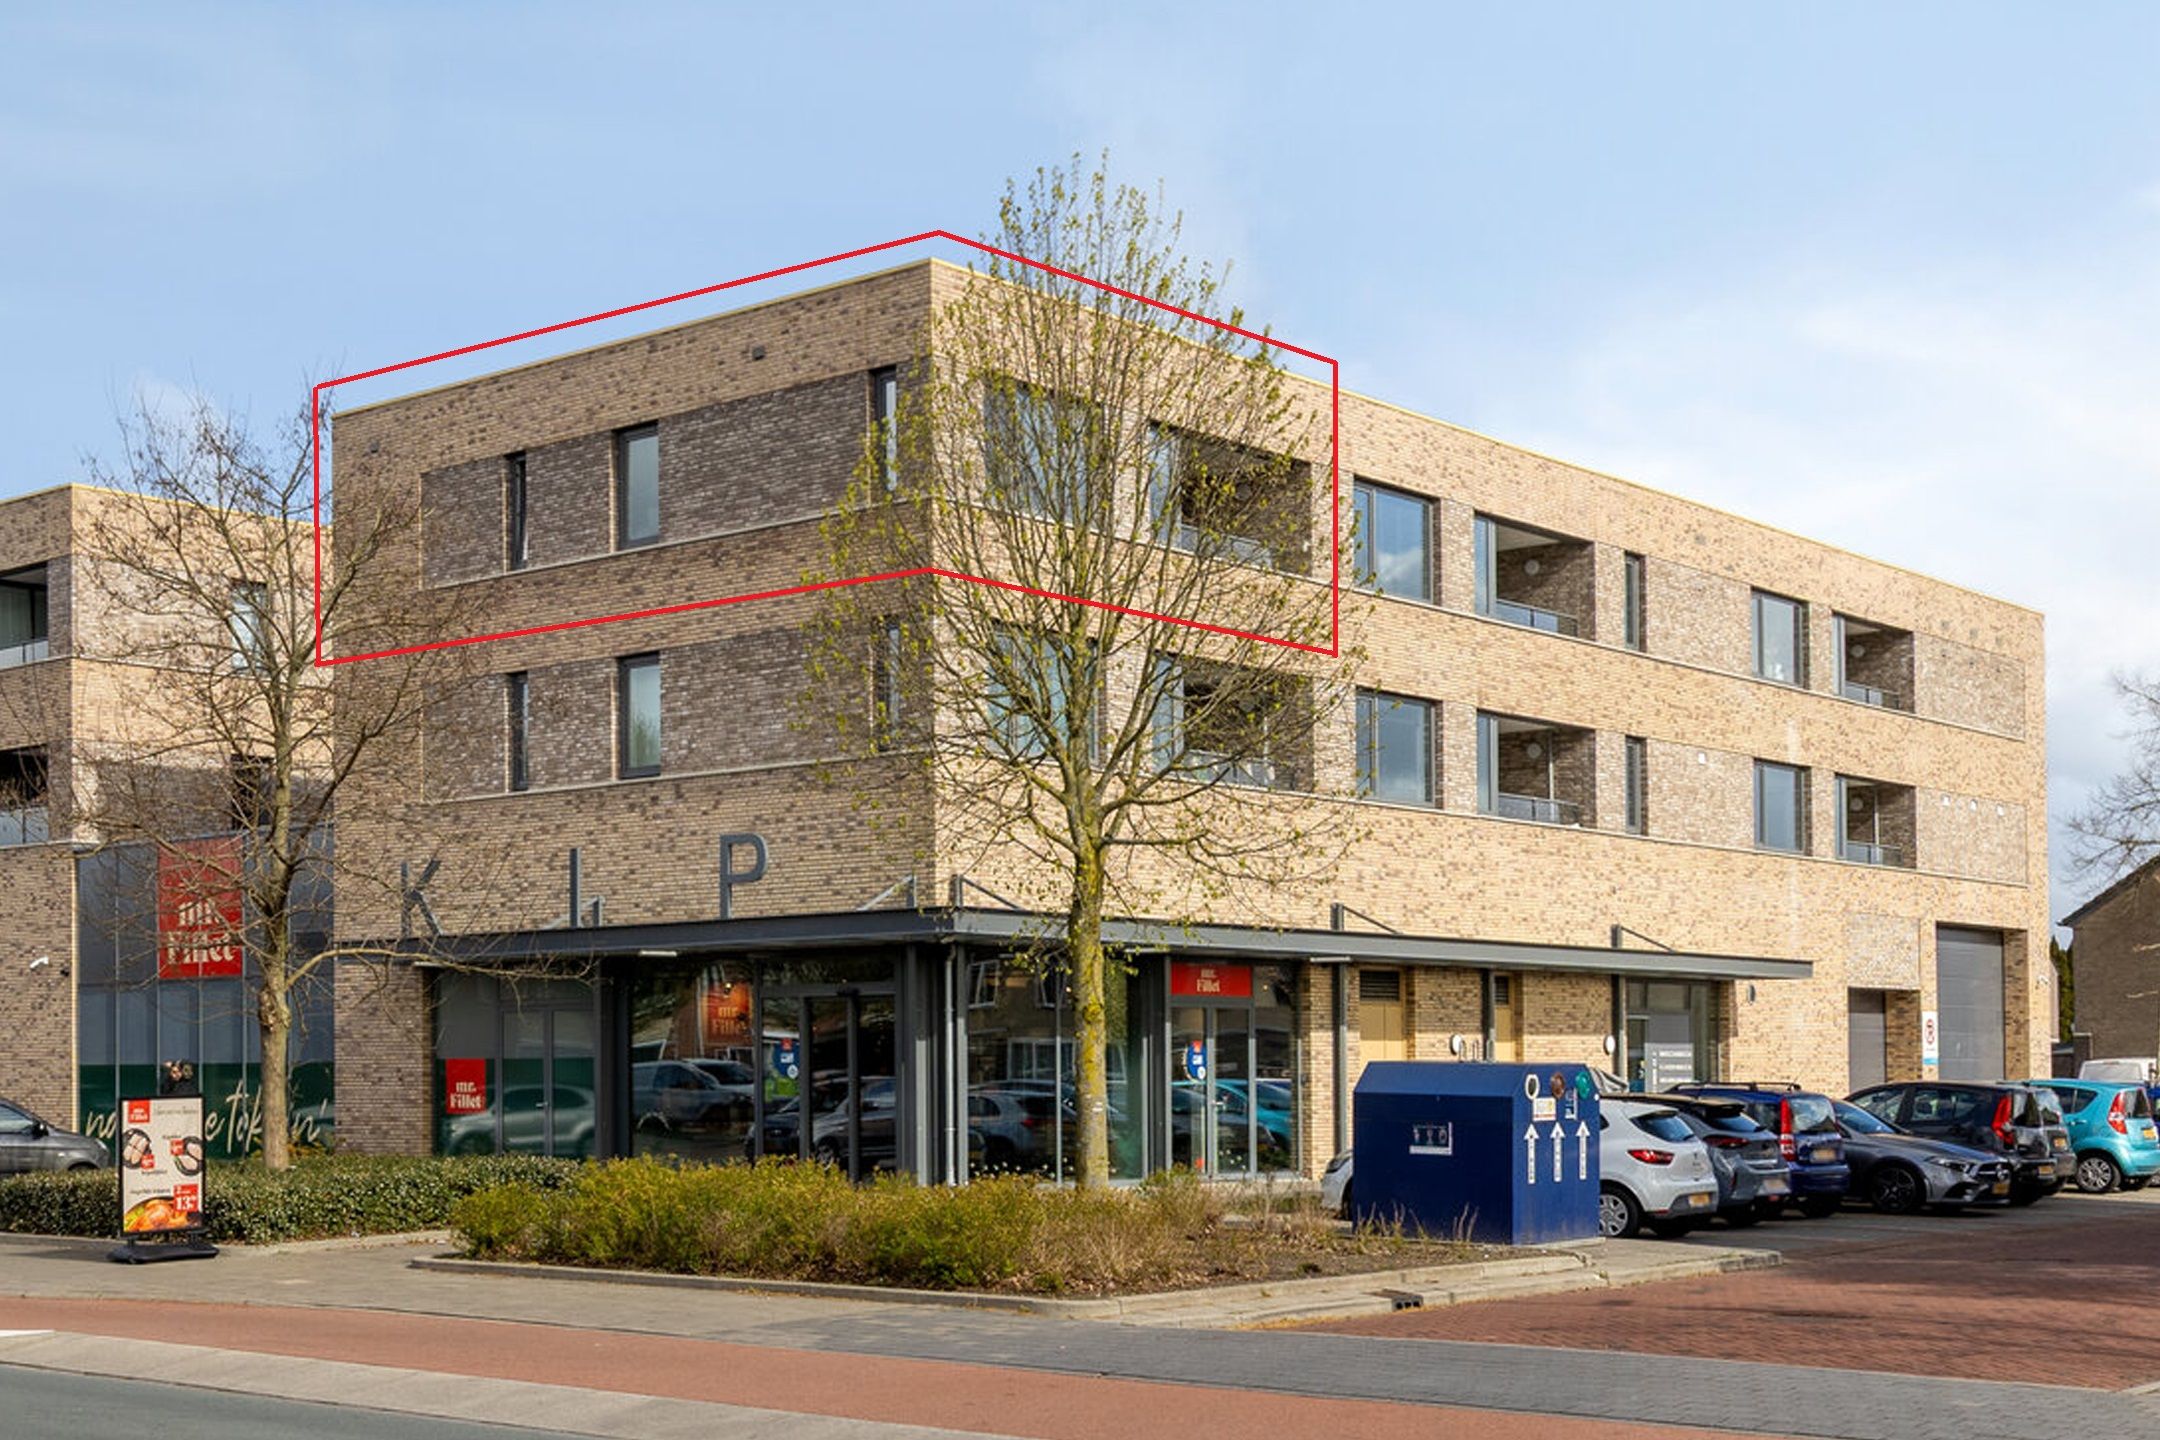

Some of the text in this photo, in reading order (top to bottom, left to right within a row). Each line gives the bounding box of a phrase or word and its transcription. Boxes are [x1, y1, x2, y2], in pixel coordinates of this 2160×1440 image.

[167, 930, 235, 965] Fillet
[718, 1007, 739, 1018] mr
[456, 1082, 477, 1093] mr.
[450, 1094, 482, 1109] Fillet
